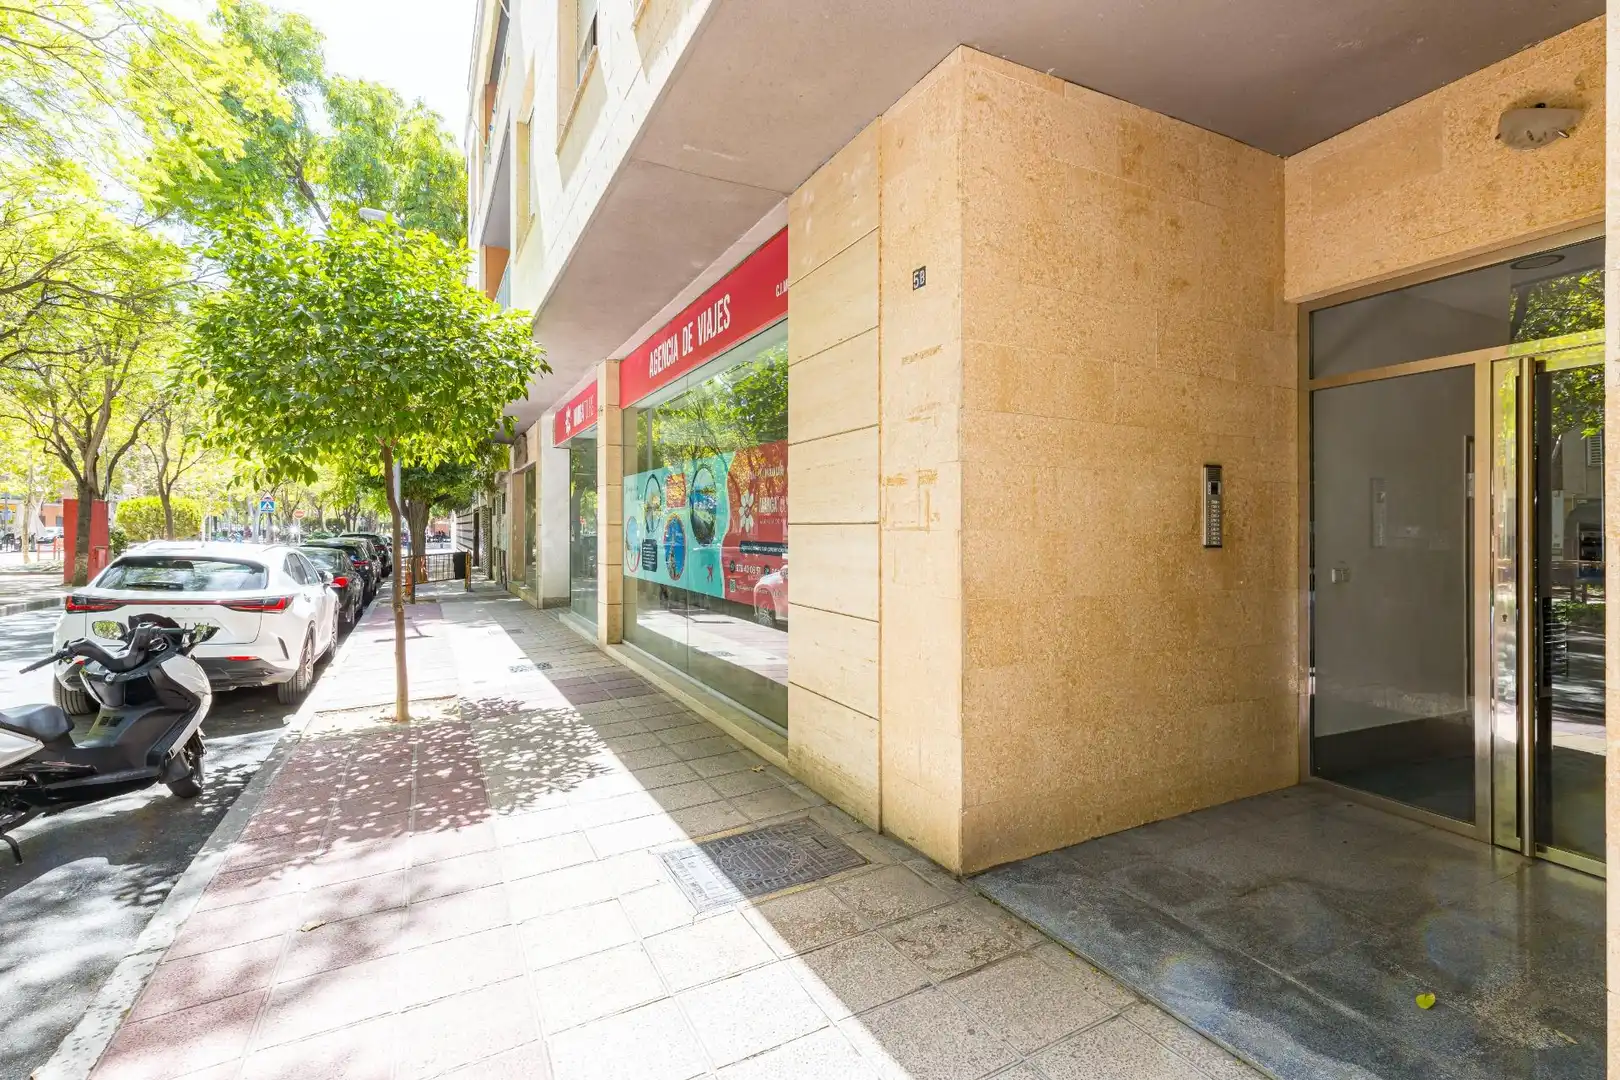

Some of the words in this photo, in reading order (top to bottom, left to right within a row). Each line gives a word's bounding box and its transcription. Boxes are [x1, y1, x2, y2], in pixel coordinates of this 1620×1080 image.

[649, 333, 679, 378] AGENCIA
[682, 321, 694, 356] DE
[697, 293, 731, 346] VIAJES
